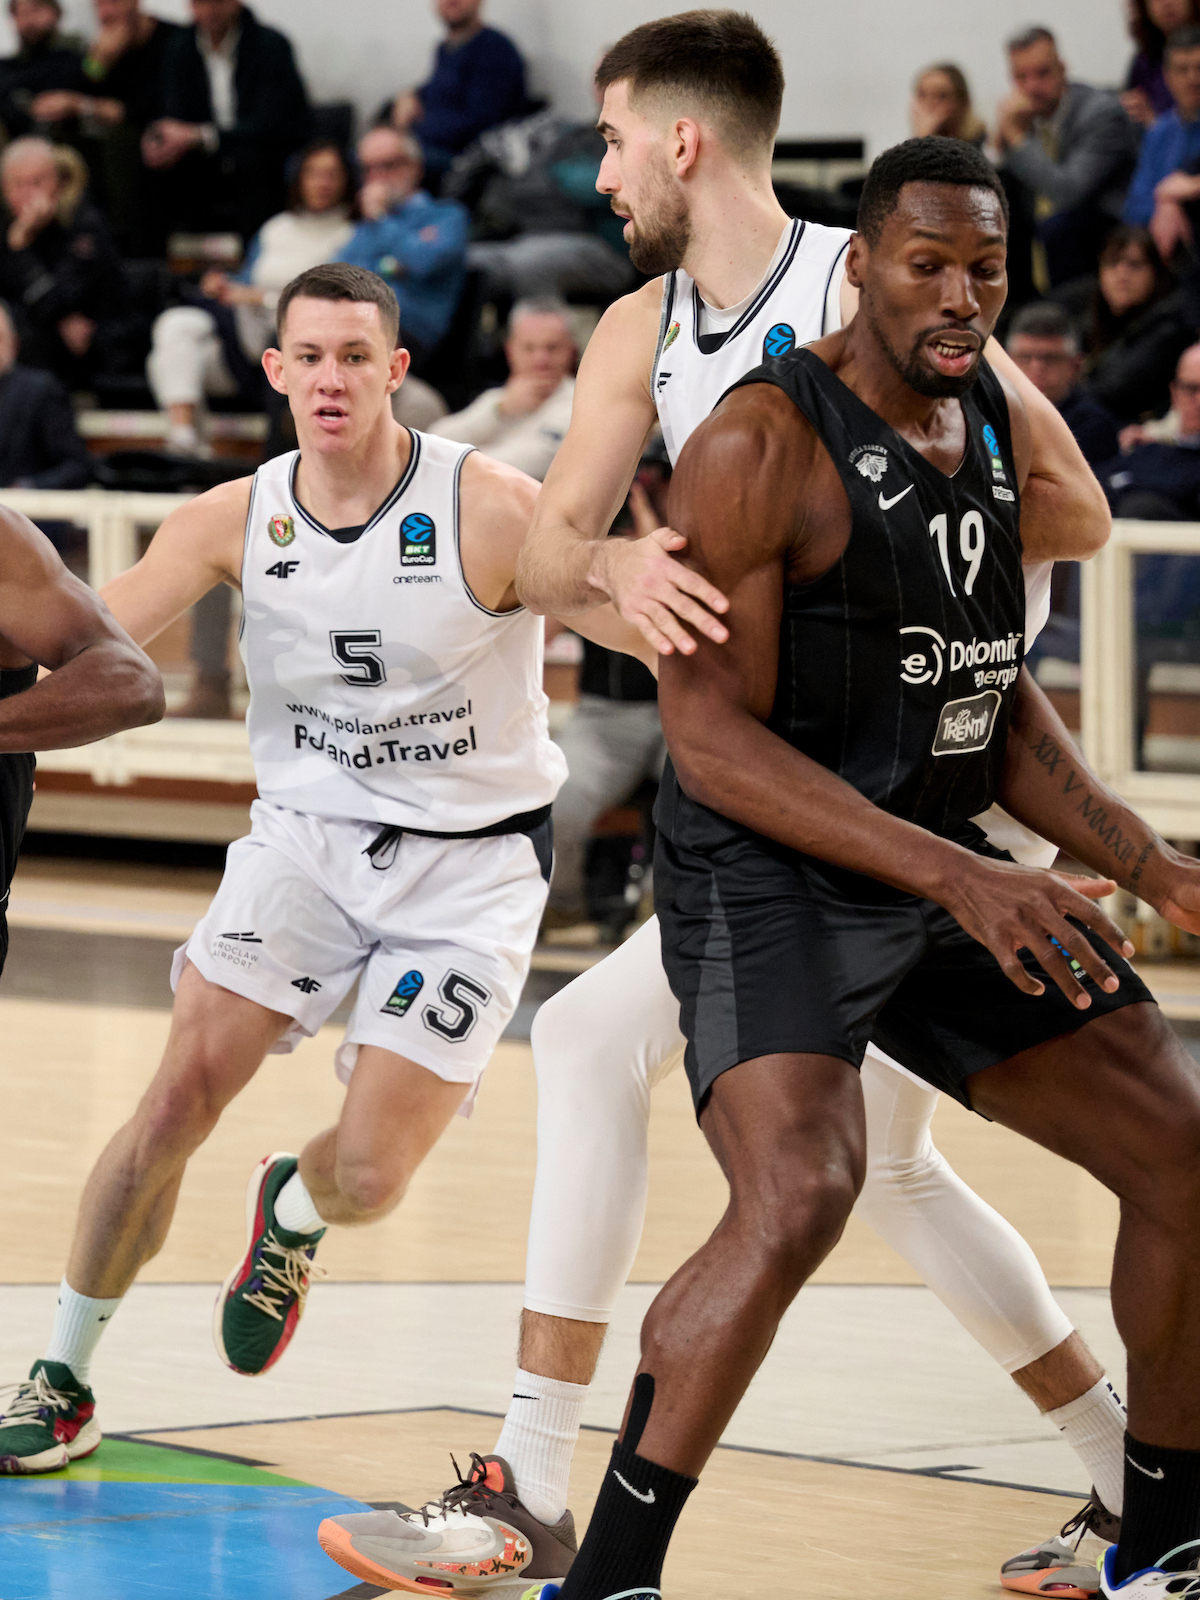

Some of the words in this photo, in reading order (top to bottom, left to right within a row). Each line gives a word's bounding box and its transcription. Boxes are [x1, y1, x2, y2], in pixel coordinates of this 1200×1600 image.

[401, 555, 435, 565] EuroCup
[929, 510, 986, 598] 19
[265, 561, 300, 579] 4F
[392, 574, 442, 585] oneteam
[329, 629, 388, 687] 5
[286, 699, 473, 736] www.poland.travel
[290, 976, 322, 994] 4F
[421, 967, 493, 1044] 5
